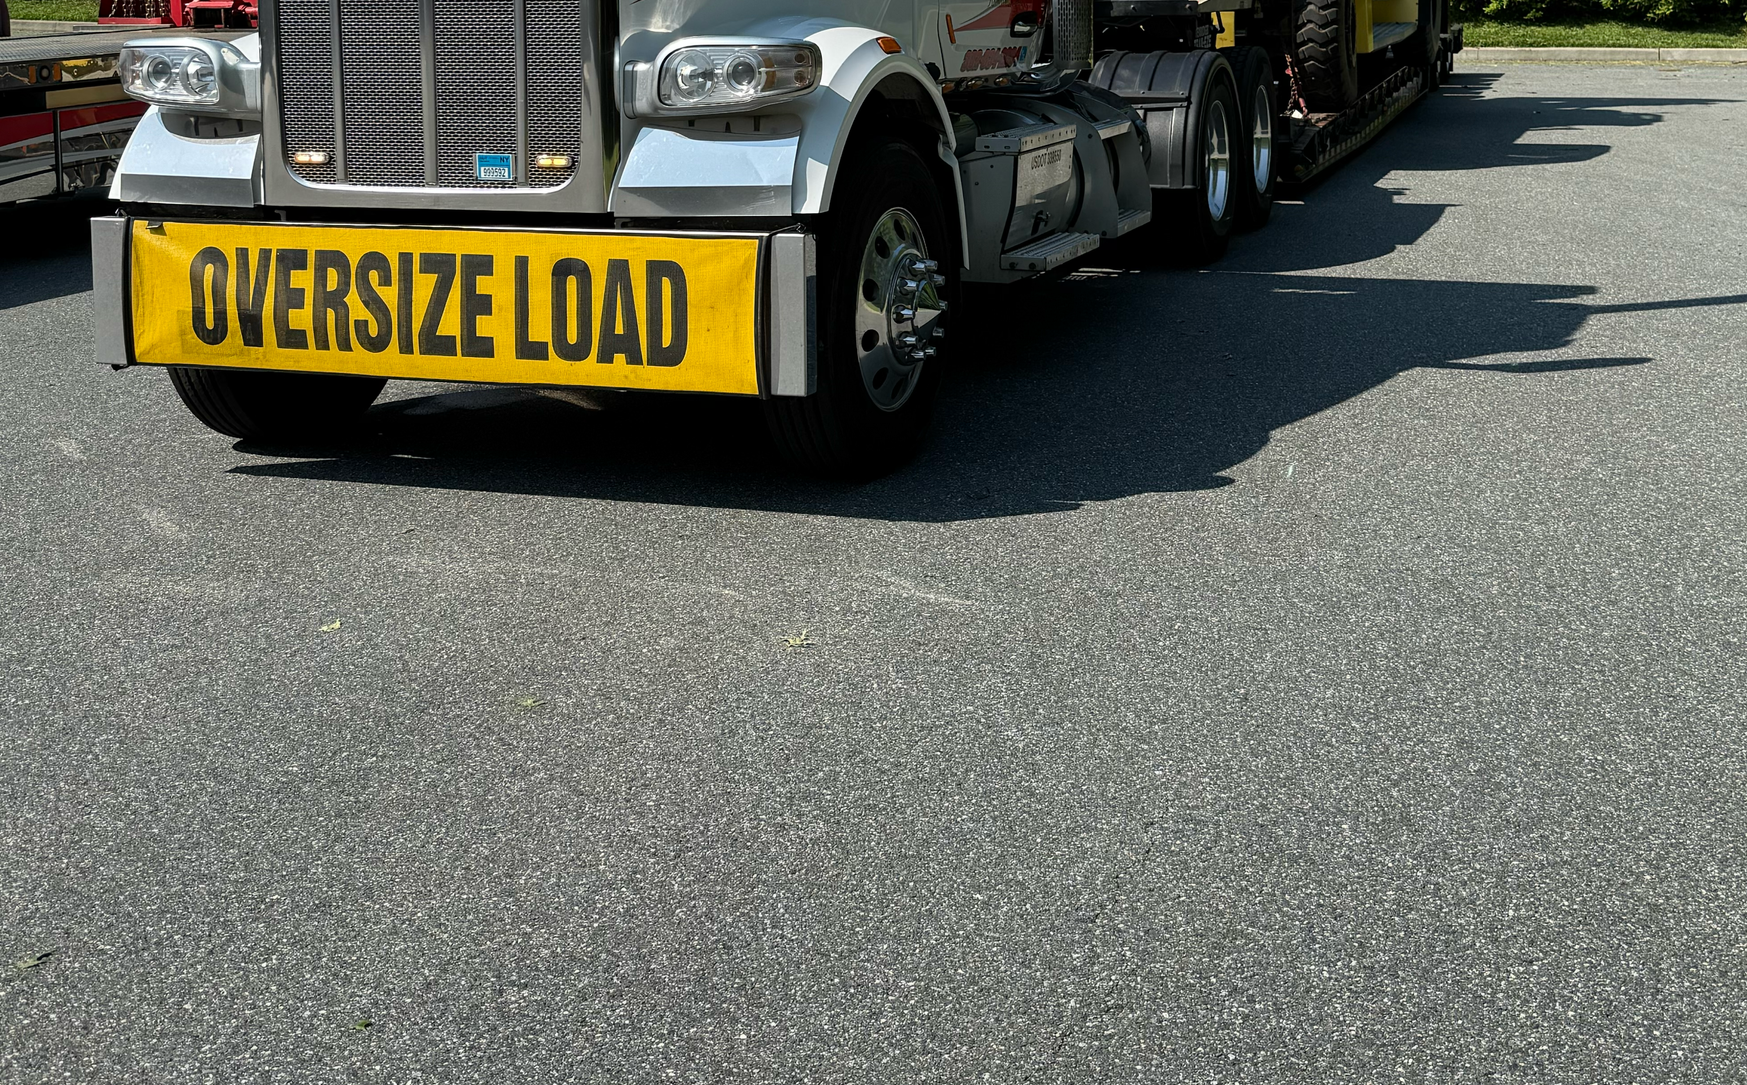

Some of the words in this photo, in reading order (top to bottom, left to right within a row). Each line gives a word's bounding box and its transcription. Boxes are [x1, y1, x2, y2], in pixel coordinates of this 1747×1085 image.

[499, 156, 510, 164] NY
[190, 246, 495, 359] OVERSIZE
[515, 255, 688, 367] LOAD
